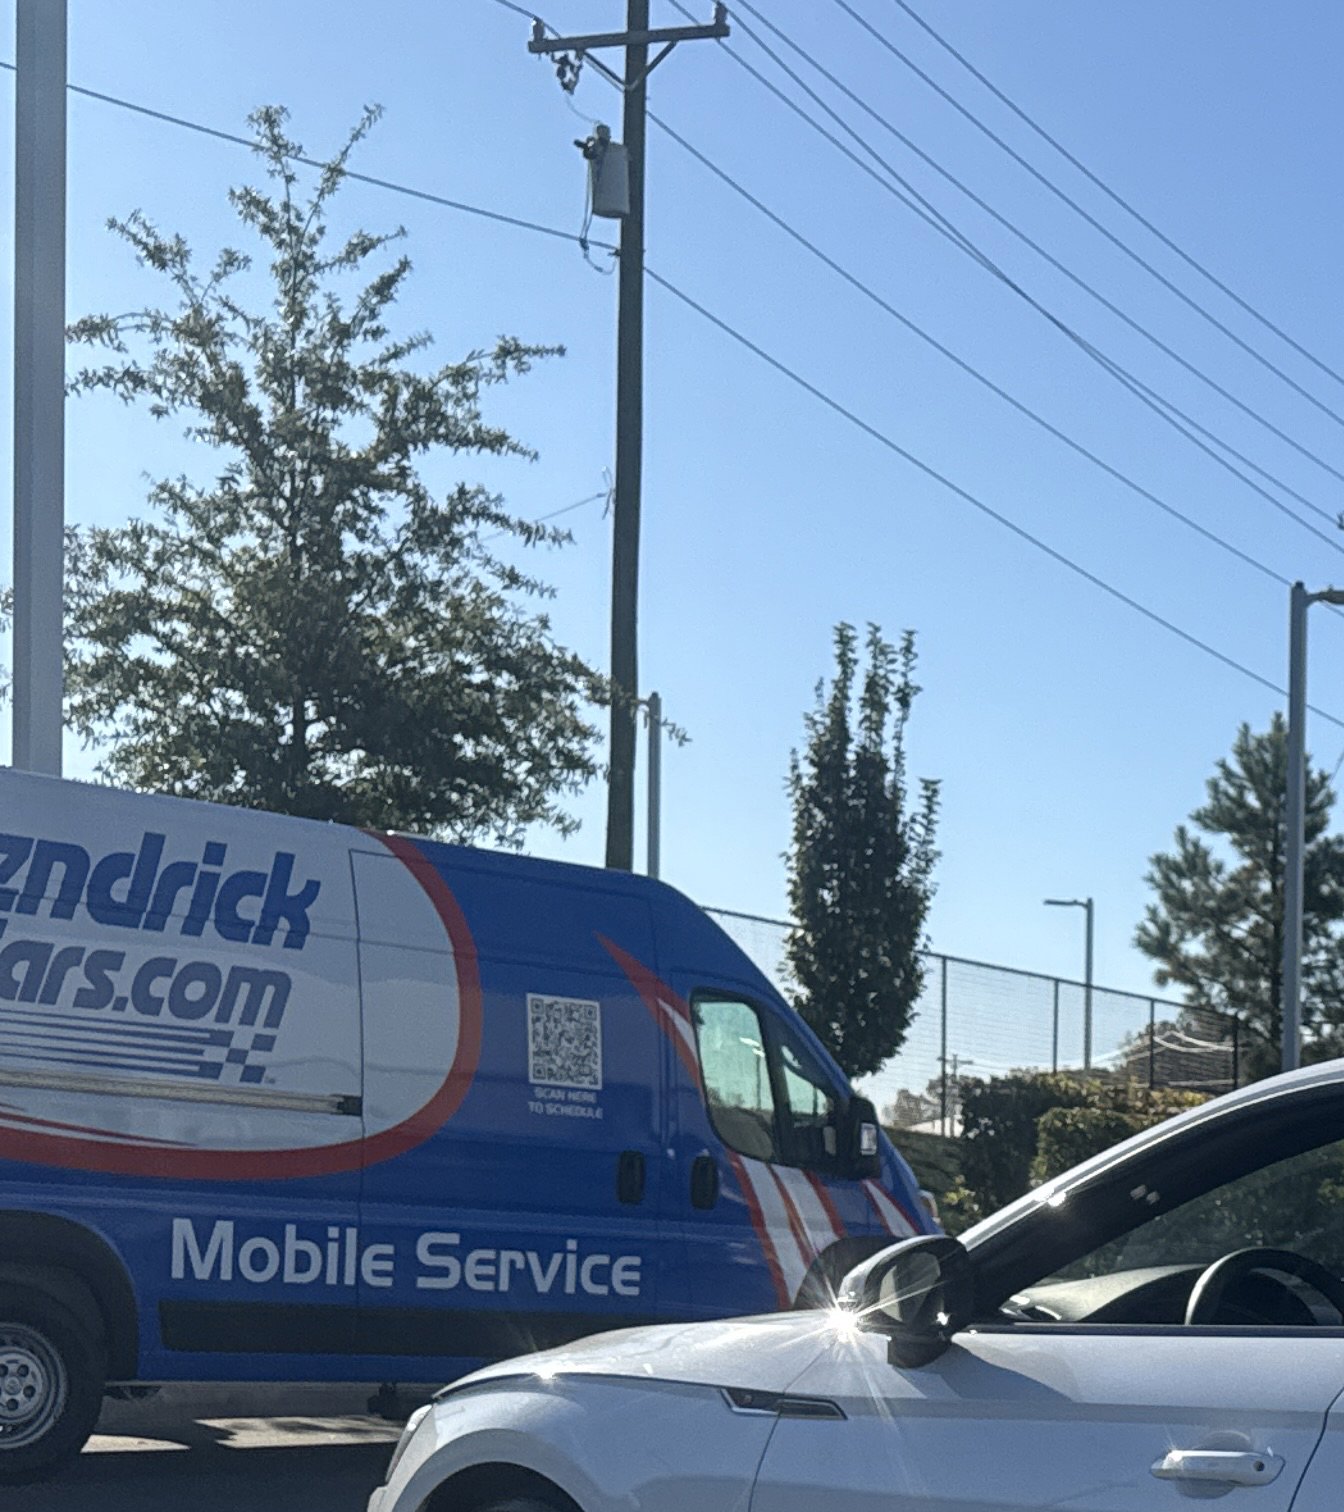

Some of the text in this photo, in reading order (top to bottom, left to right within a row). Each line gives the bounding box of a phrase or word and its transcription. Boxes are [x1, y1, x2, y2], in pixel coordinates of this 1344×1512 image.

[0, 918, 292, 1028] ars.com
[528, 1101, 604, 1120] TO SCHEDULE
[534, 1087, 597, 1104] SCAN HERE
[170, 1217, 642, 1296] Mobile Service
